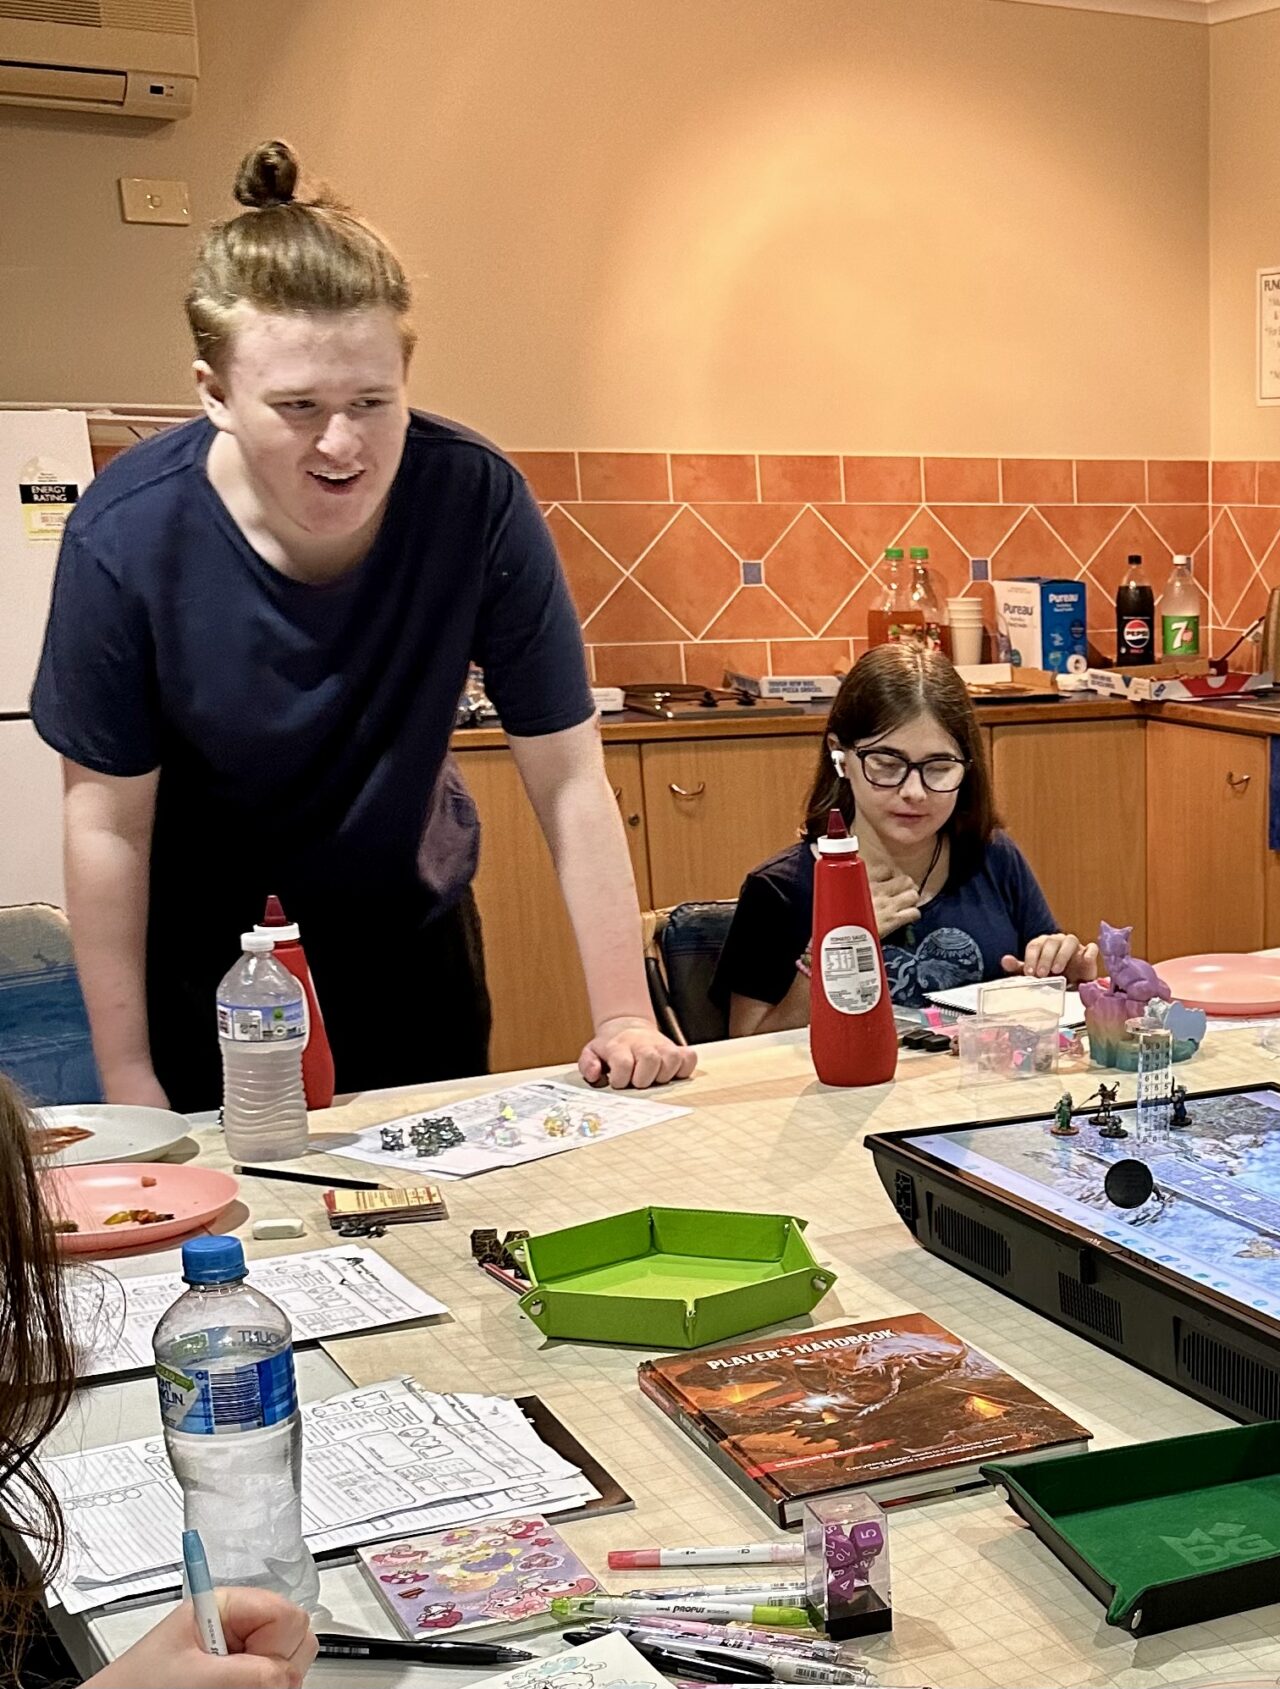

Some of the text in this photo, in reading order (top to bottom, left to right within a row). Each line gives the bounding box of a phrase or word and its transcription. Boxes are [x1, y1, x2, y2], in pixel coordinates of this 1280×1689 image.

[31, 486, 66, 494] ENERGY
[33, 494, 67, 502] RATING
[1048, 594, 1079, 603] Pureau
[1004, 603, 1033, 616] Pureau
[1170, 620, 1188, 650] 7
[706, 1329, 898, 1370] PLAYER'S HANDBOOK
[860, 1529, 877, 1539] 5
[840, 1580, 850, 1590] 4
